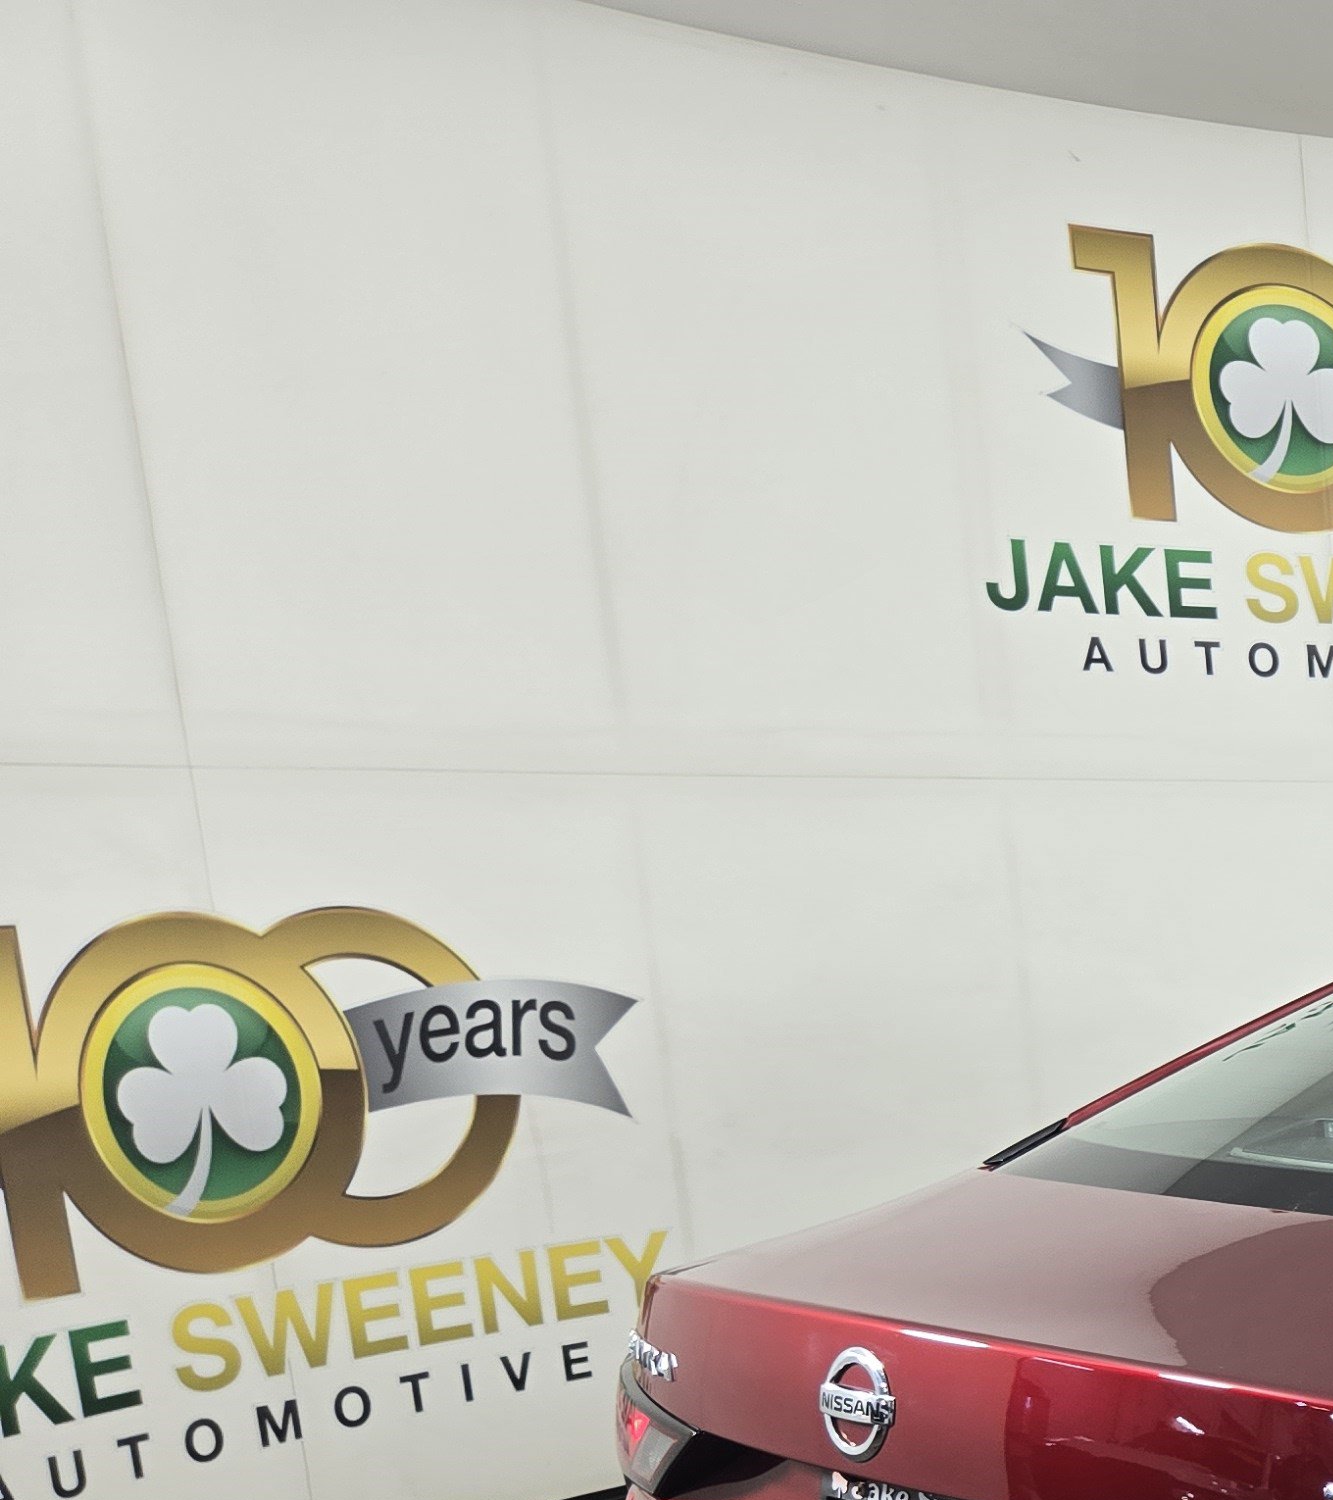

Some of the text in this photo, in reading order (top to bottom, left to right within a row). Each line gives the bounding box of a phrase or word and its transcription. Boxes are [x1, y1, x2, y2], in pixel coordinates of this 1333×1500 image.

[986, 538, 1218, 619] JAKE
[373, 997, 577, 1093] years
[171, 1230, 669, 1392] SWEENEY
[821, 1391, 880, 1418] NISSAN
